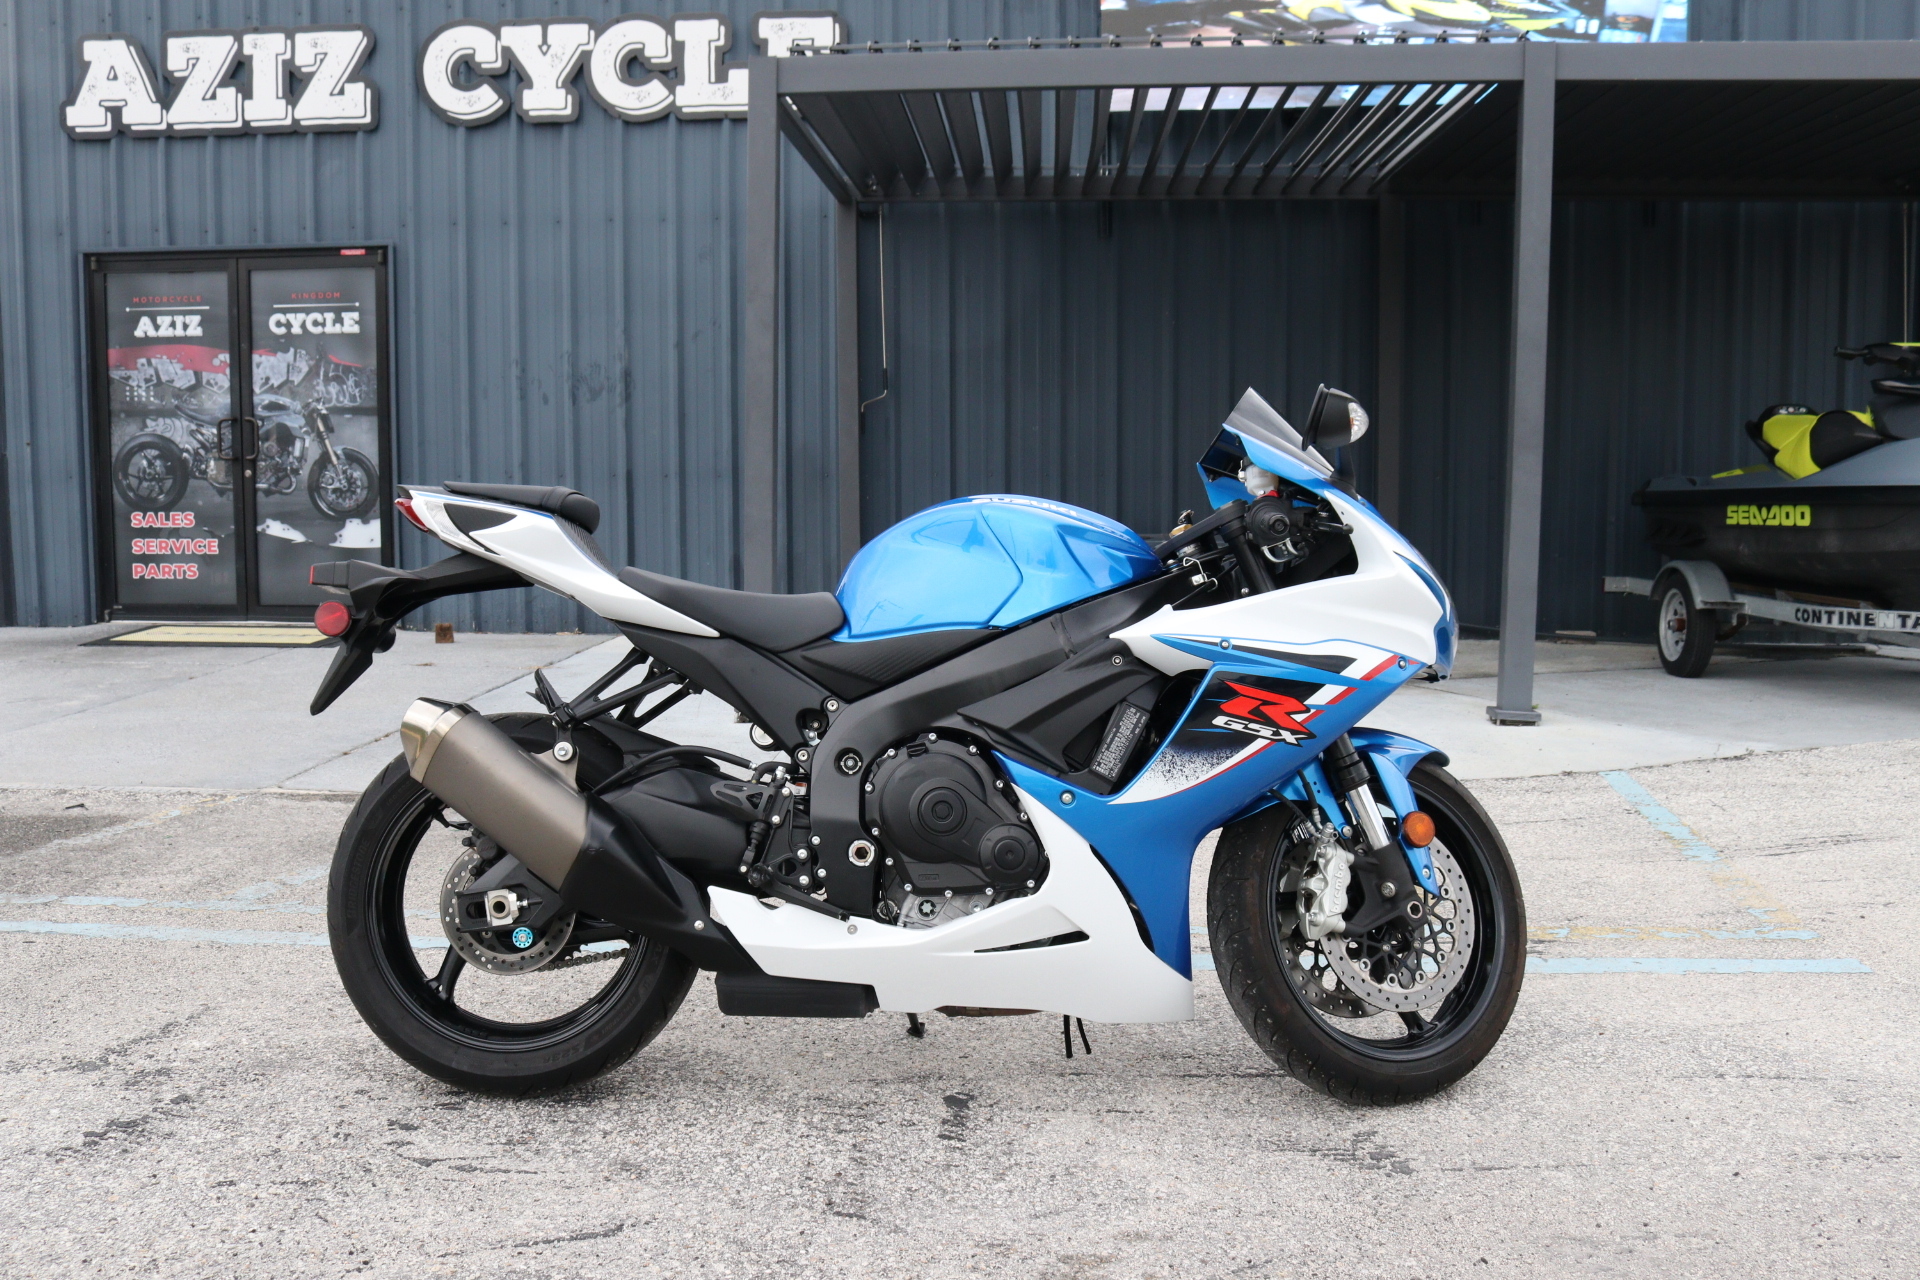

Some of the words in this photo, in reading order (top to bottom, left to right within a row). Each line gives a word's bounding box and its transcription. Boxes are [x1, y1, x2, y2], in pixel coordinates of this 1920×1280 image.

[66, 31, 371, 132] AZIZ
[133, 295, 202, 304] MOTORCYCLE
[134, 315, 203, 338] AZIZ
[268, 311, 360, 335] CYCLE
[131, 511, 196, 528] SALES
[132, 538, 219, 554] SERVICE
[132, 563, 199, 579] PARTS
[1212, 715, 1309, 745] GSX
[1330, 862, 1346, 914] brembo
